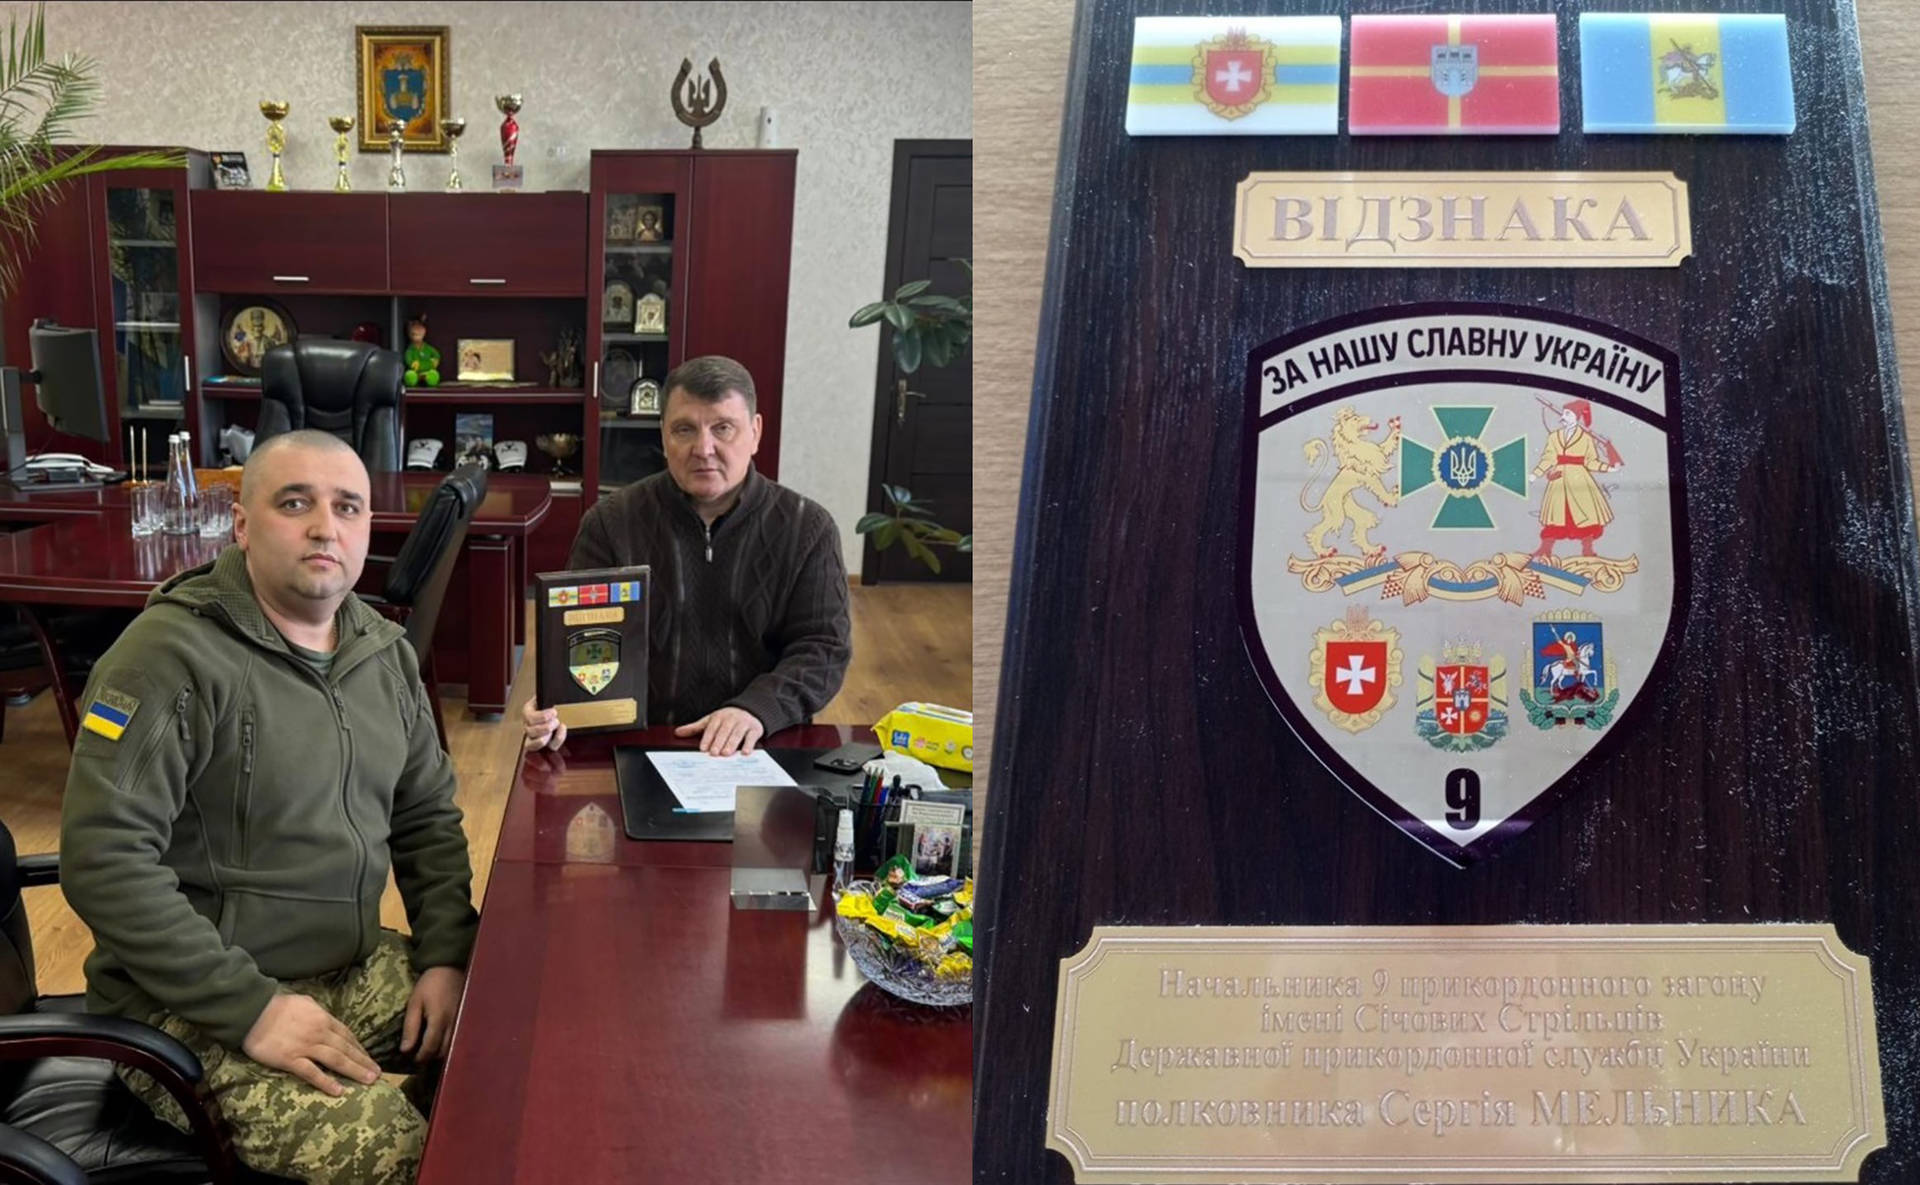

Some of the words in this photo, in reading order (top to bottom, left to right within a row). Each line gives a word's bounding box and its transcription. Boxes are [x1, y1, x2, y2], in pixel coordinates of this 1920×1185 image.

[1267, 195, 1653, 253] ВІДЗНАКА
[1263, 359, 1307, 396] ЗА
[1308, 331, 1400, 380] НАШУ
[1407, 327, 1529, 360] СЛАВНУ
[1534, 332, 1662, 393] УКРАЇНУ
[1444, 767, 1481, 830] 9
[1159, 968, 1362, 998] Начальника
[1372, 968, 1390, 998] 9
[1402, 975, 1651, 1005] прикордонного
[1663, 975, 1768, 1004] загону
[1260, 1003, 1343, 1034] імені
[1353, 1003, 1487, 1034] Січових
[1498, 1002, 1664, 1041] Стрільців
[1111, 1038, 1294, 1075] Державної
[1303, 1040, 1534, 1075] прикордонної
[1543, 1039, 1665, 1076] служби
[1675, 1039, 1811, 1075] України
[1115, 1098, 1366, 1127] полковника
[1379, 1089, 1516, 1136] Сергія
[1531, 1088, 1808, 1128] МЕЛЬНИКА
